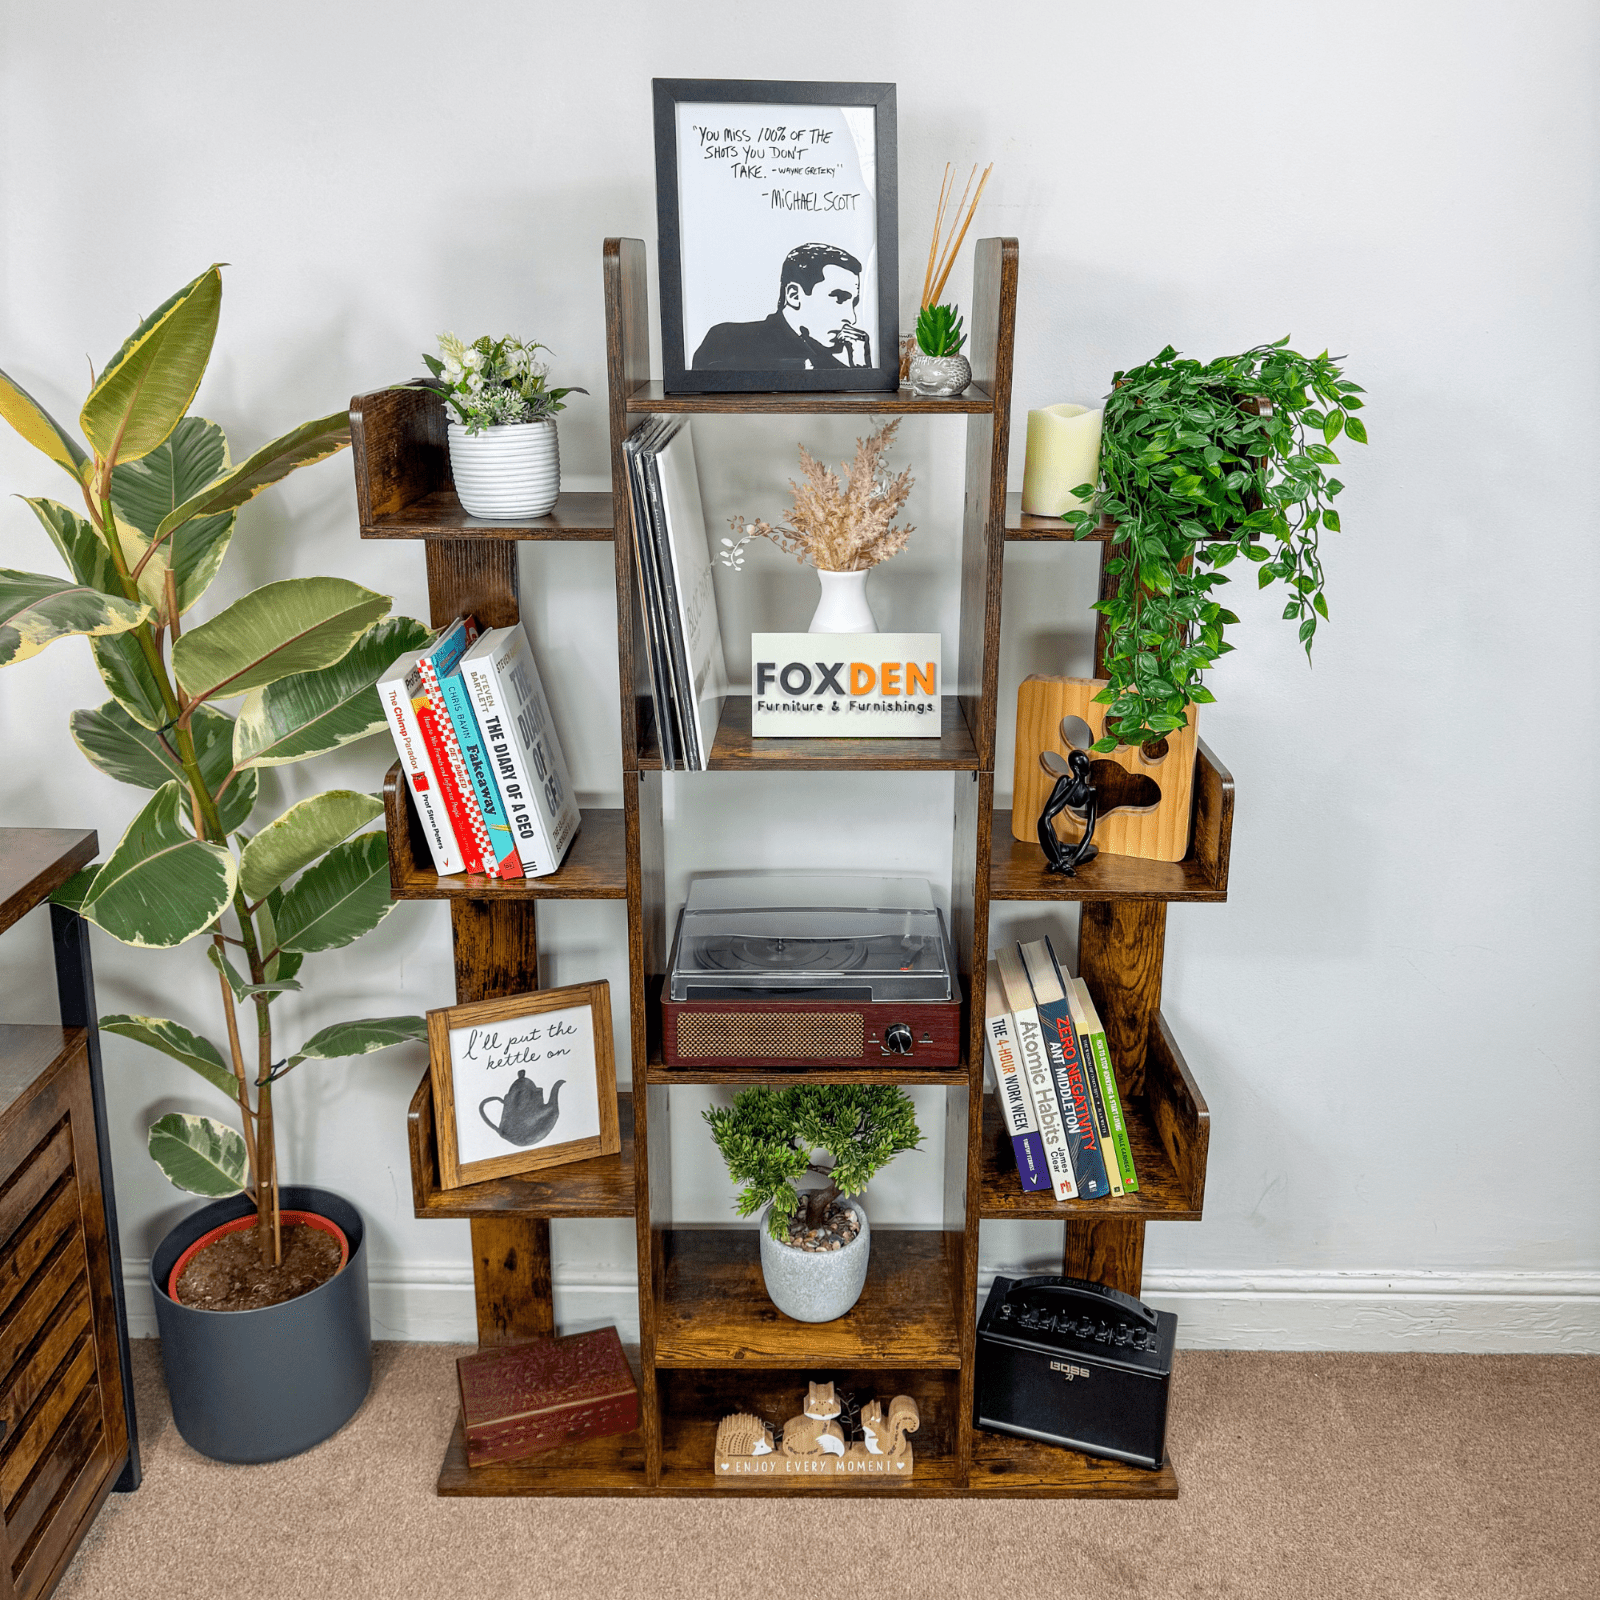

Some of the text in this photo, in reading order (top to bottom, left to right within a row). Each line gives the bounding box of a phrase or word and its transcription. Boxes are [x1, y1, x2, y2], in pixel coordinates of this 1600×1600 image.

[758, 127, 786, 142] 100%
[790, 130, 806, 141] OF
[810, 129, 833, 144] THE
[704, 145, 808, 164] SHOTS YOU DON'T
[731, 163, 767, 179] TAKE.
[824, 192, 860, 211] SCOTT
[470, 671, 490, 714] BARTLETT
[480, 674, 495, 707] STEVEN
[756, 662, 935, 696] FOXDEN
[758, 700, 934, 714] Furniture & Furnishings
[448, 686, 496, 816] CHRIS BAVIN Fakeaway
[389, 690, 444, 850] The Chimp Paradox Prof Steve Peters
[449, 748, 468, 788] GET BAKED
[486, 716, 534, 840] THE DIARY OF A CEO
[504, 1028, 542, 1055] put
[546, 1021, 578, 1038] the
[486, 1047, 571, 1070] kettle on
[992, 1018, 1029, 1130] THE 4-HOUR WORK WEEK
[1020, 1021, 1060, 1145] Atomic Habits
[1050, 1042, 1080, 1134] ANT MIDDLETON
[1056, 1014, 1097, 1151] ZERO NEGATIVITY
[1050, 1151, 1060, 1172] Clear
[1058, 1147, 1068, 1173] James
[1049, 1360, 1090, 1378] BOSS
[736, 1460, 891, 1472] ENJOY EVERY MOMENT
